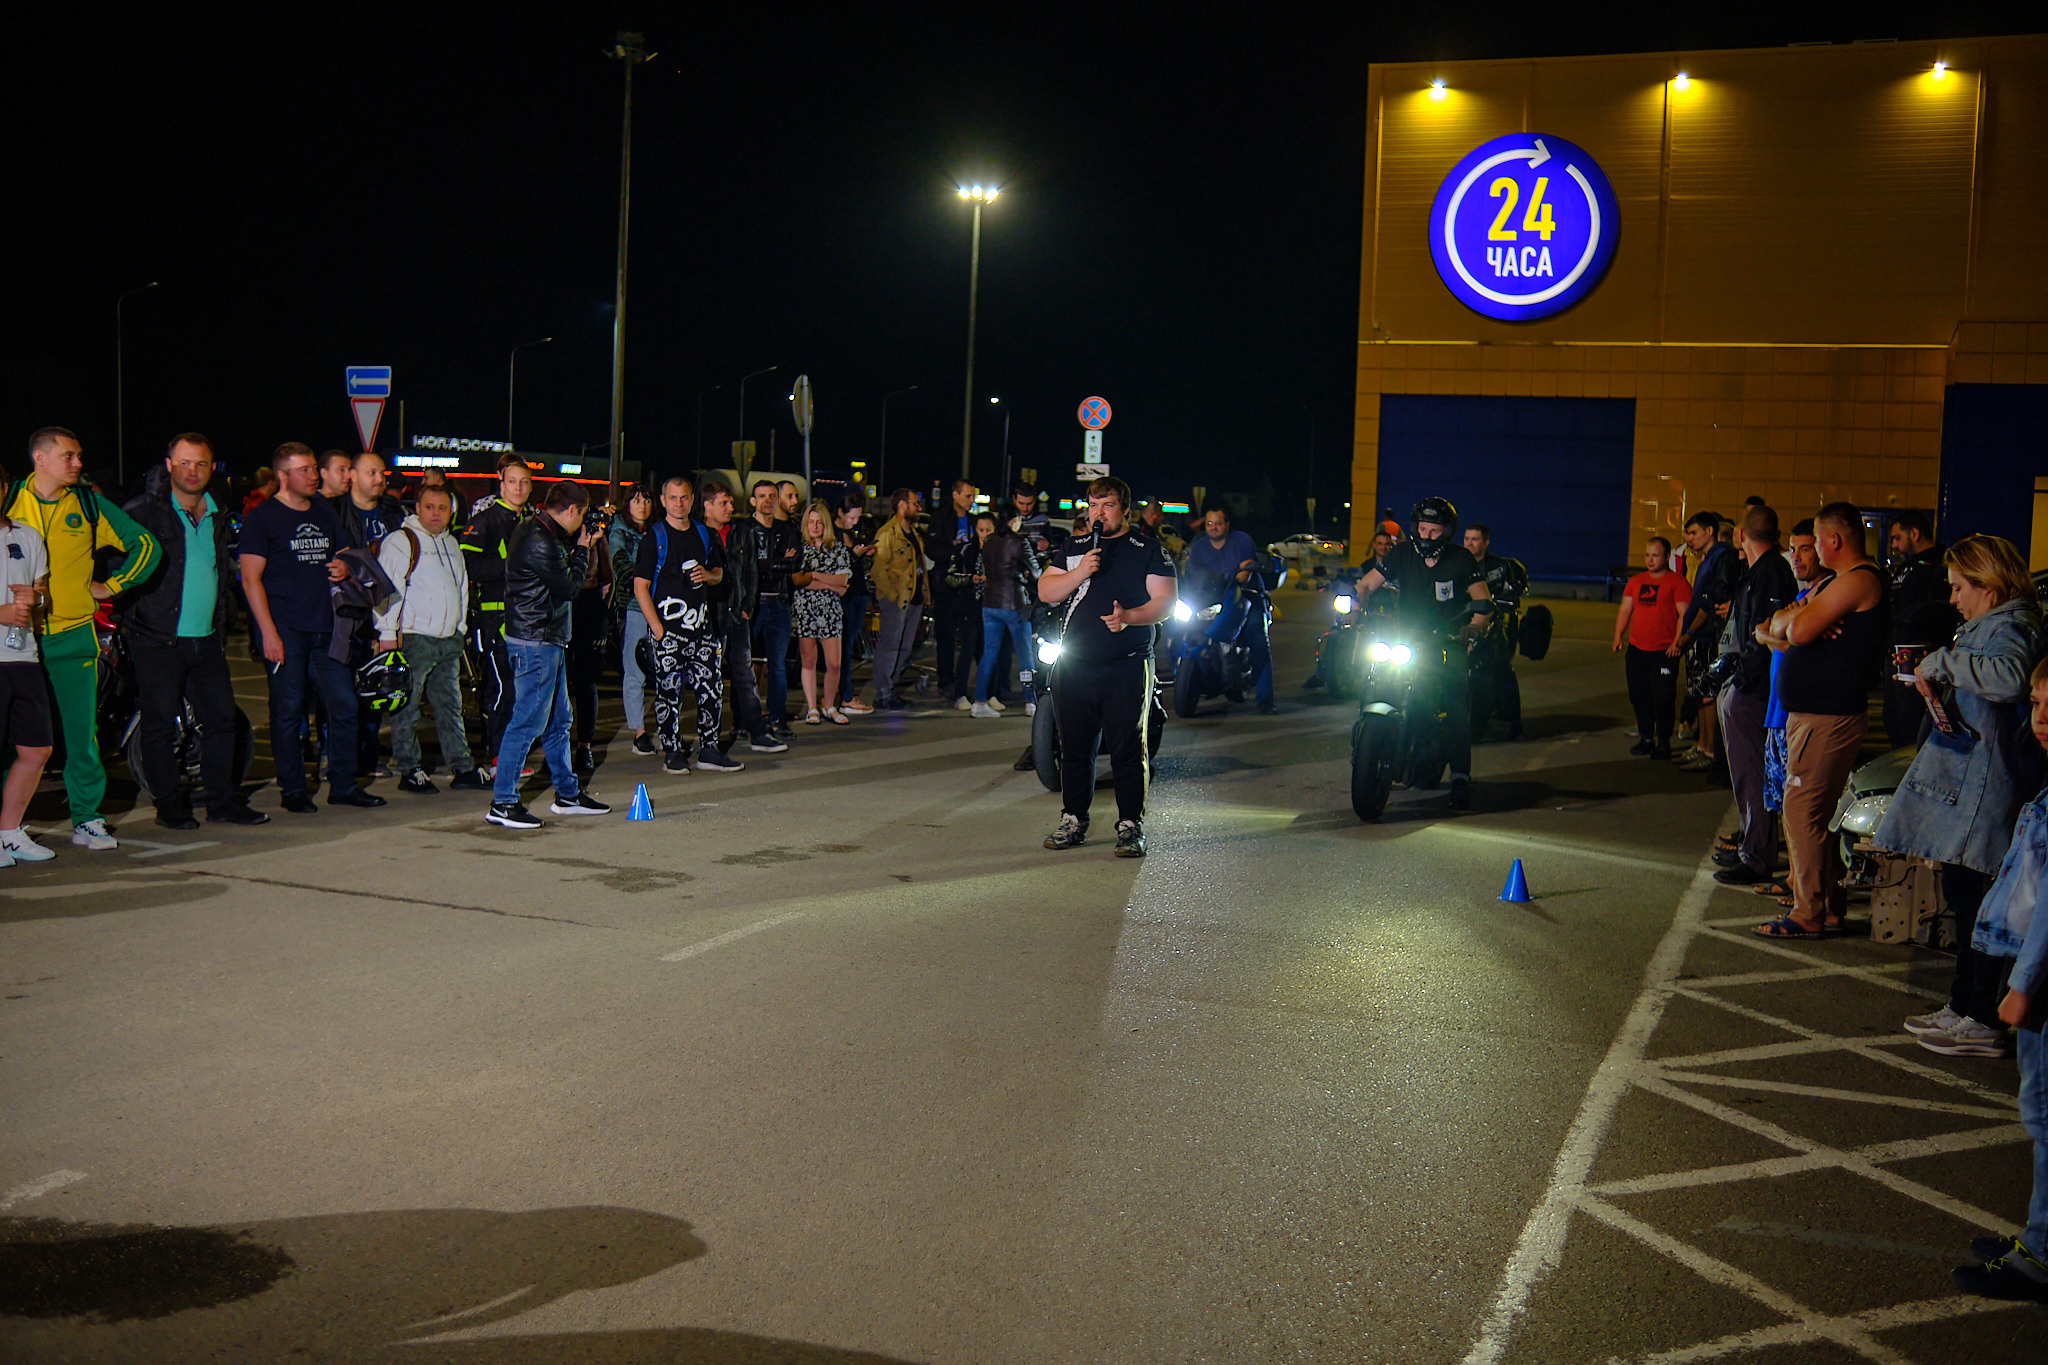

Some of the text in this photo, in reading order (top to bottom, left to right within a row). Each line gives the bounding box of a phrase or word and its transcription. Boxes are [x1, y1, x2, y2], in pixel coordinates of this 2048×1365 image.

[1488, 177, 1556, 241] 24
[1486, 246, 1554, 277] ЧАСА
[290, 537, 330, 550] MUSTANG
